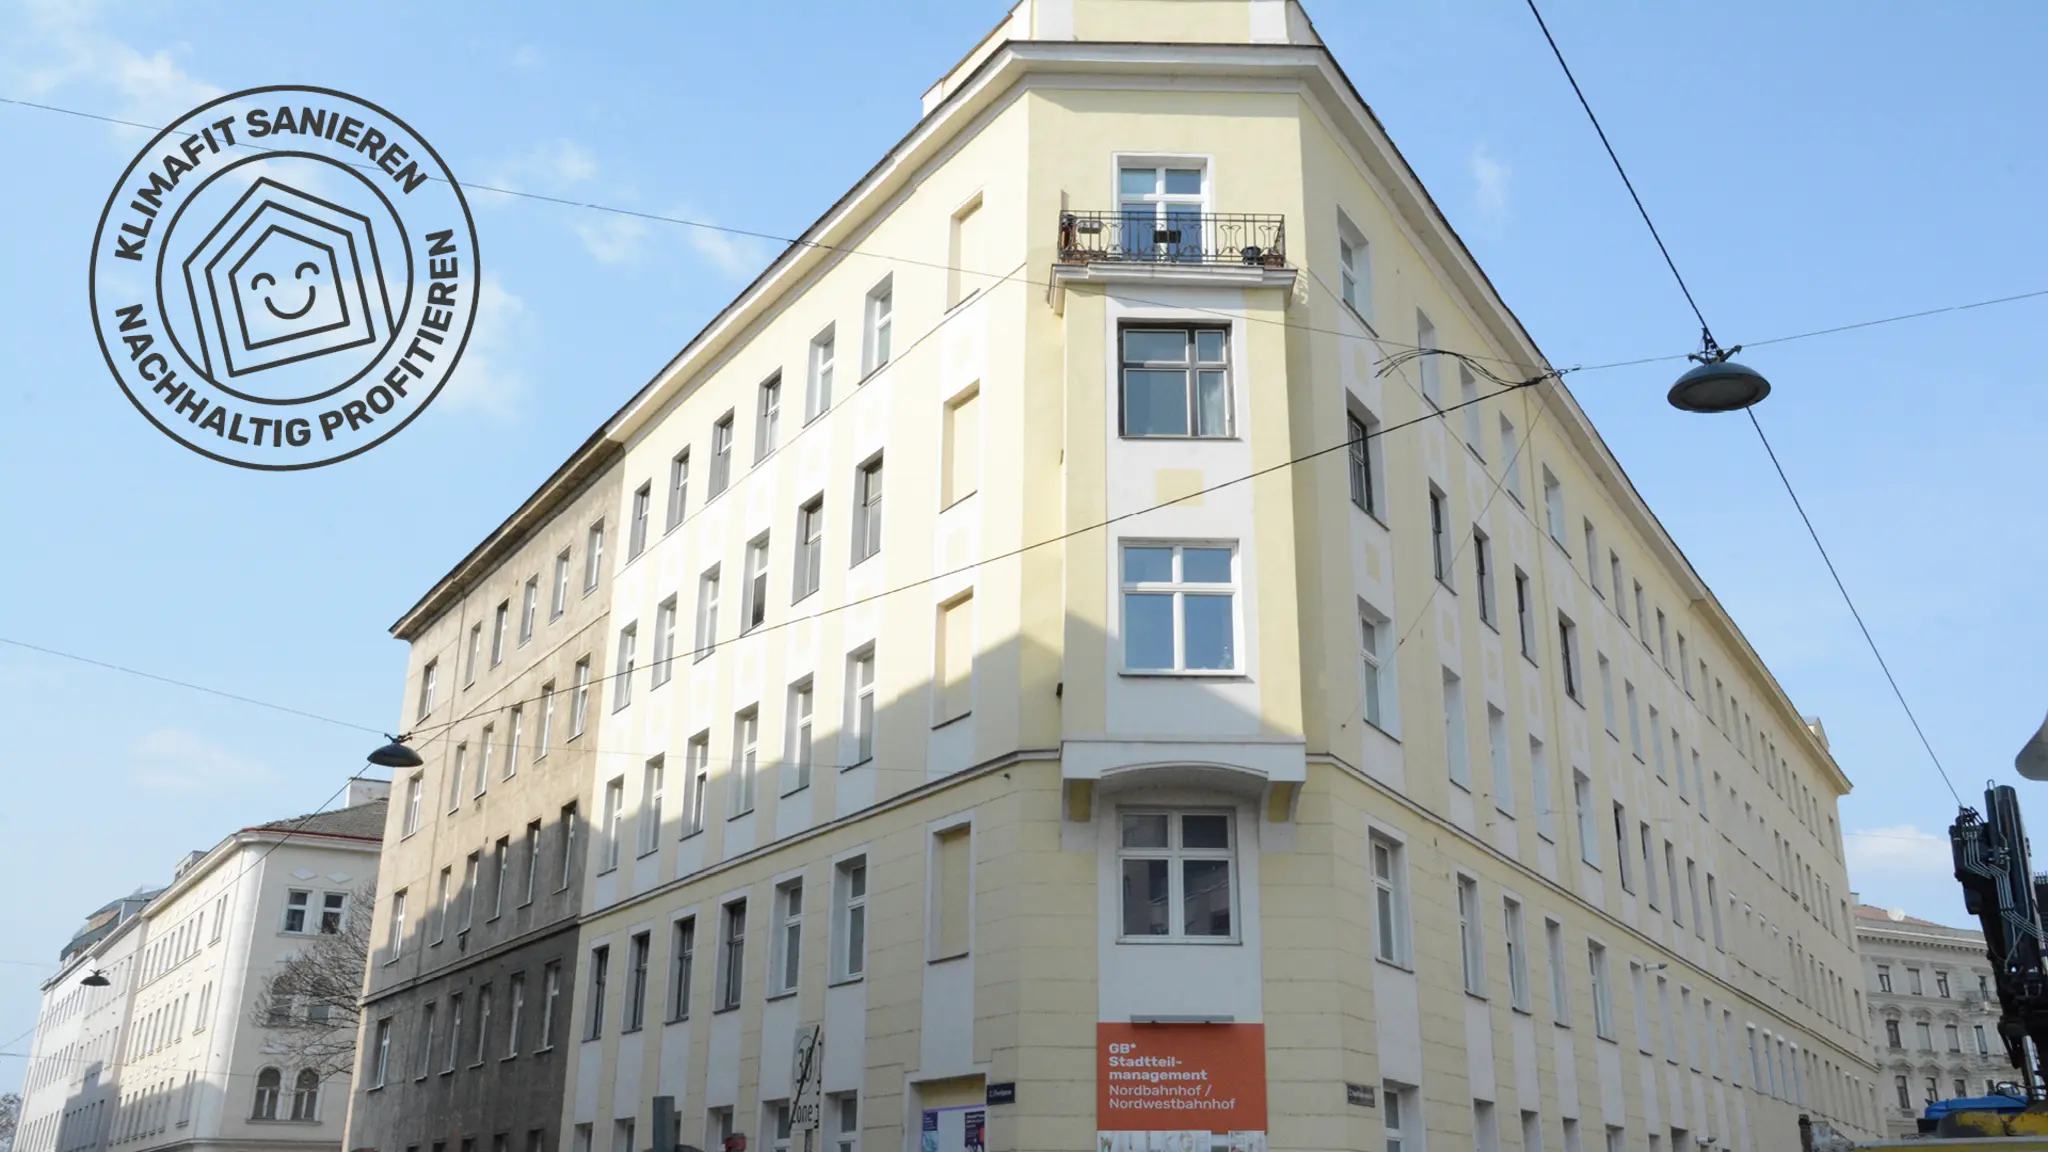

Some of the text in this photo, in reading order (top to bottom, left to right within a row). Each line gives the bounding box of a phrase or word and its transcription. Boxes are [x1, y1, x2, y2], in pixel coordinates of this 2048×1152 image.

[1108, 1056, 1183, 1067] Stadtteil-
[1108, 1069, 1208, 1083] management
[1108, 1084, 1202, 1096] Nordbahnhof
[1108, 1098, 1236, 1109] Nordwestbahnhof
